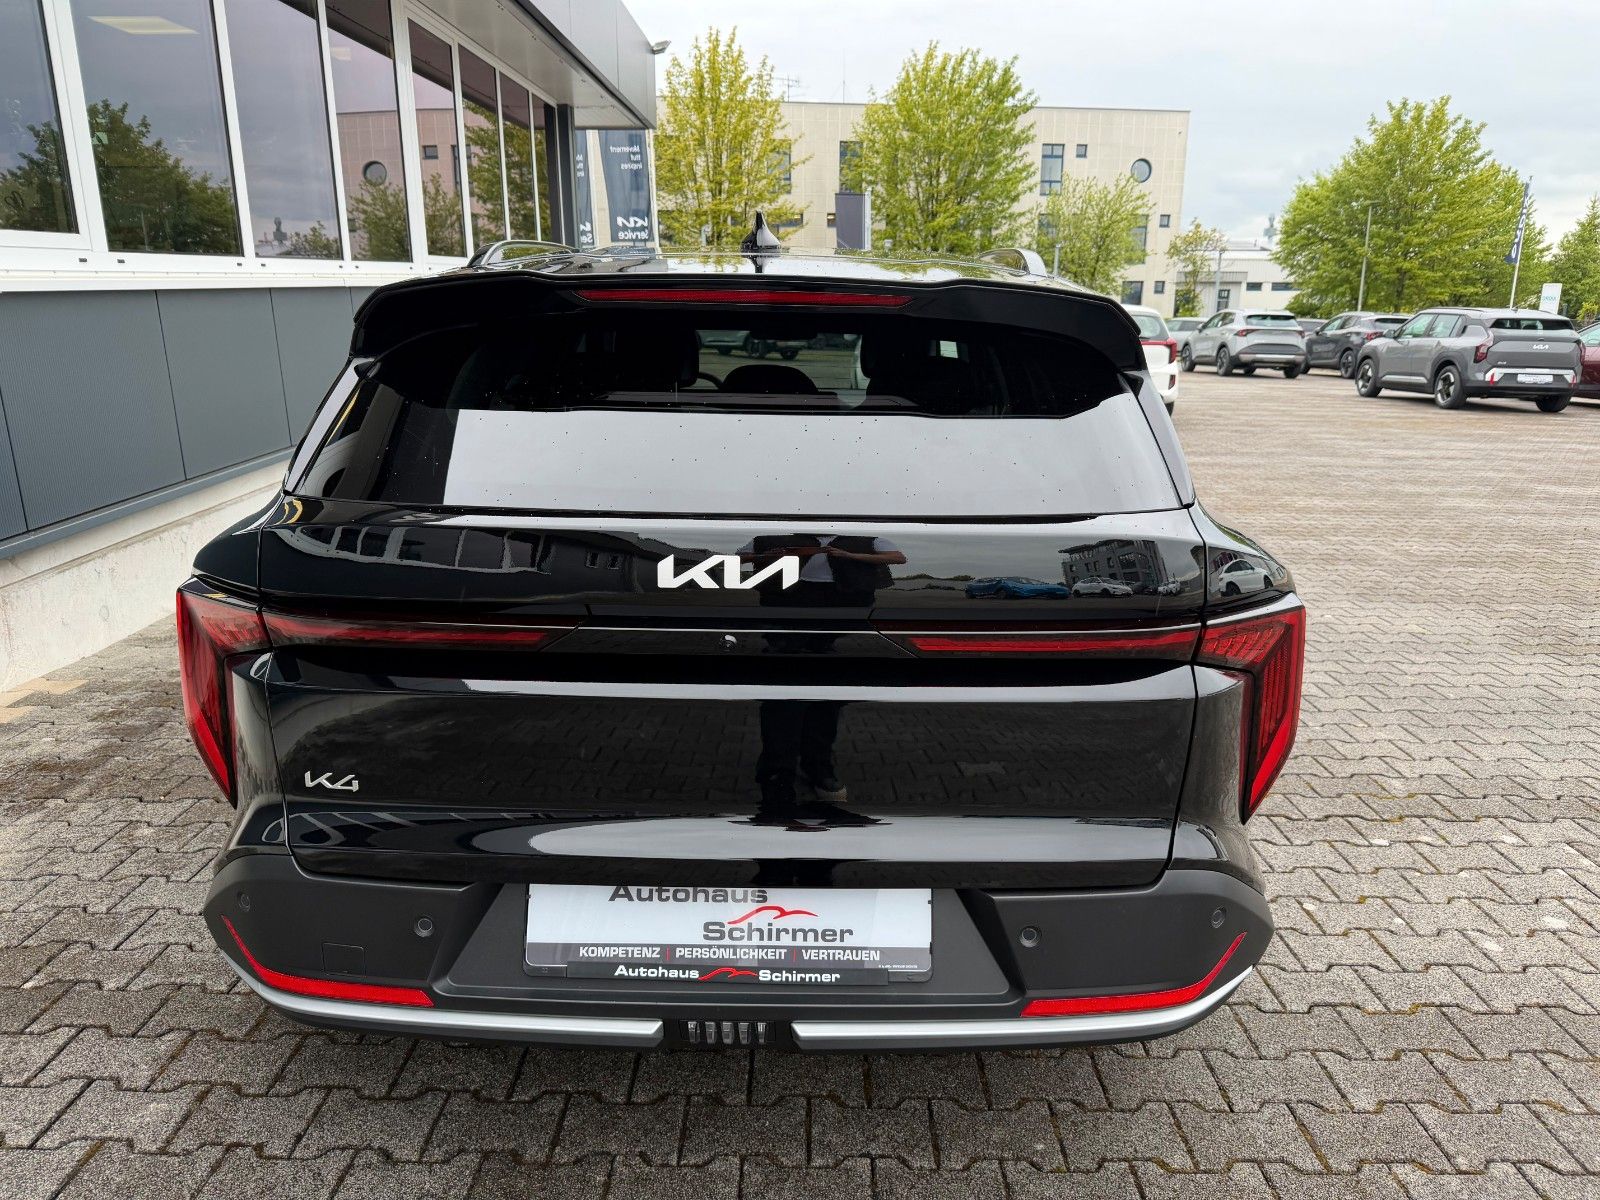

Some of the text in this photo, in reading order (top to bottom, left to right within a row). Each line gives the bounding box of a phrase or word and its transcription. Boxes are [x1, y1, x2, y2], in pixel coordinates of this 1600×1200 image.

[657, 554, 800, 590] KIA
[304, 770, 359, 792] K4
[607, 884, 768, 904] Autohaus
[703, 921, 854, 943] Schirmer
[579, 945, 881, 961] KOMPETENZ PERSÖNLICHKEIT VERTRAUEN
[614, 964, 841, 983] Autohaus Schirmer
